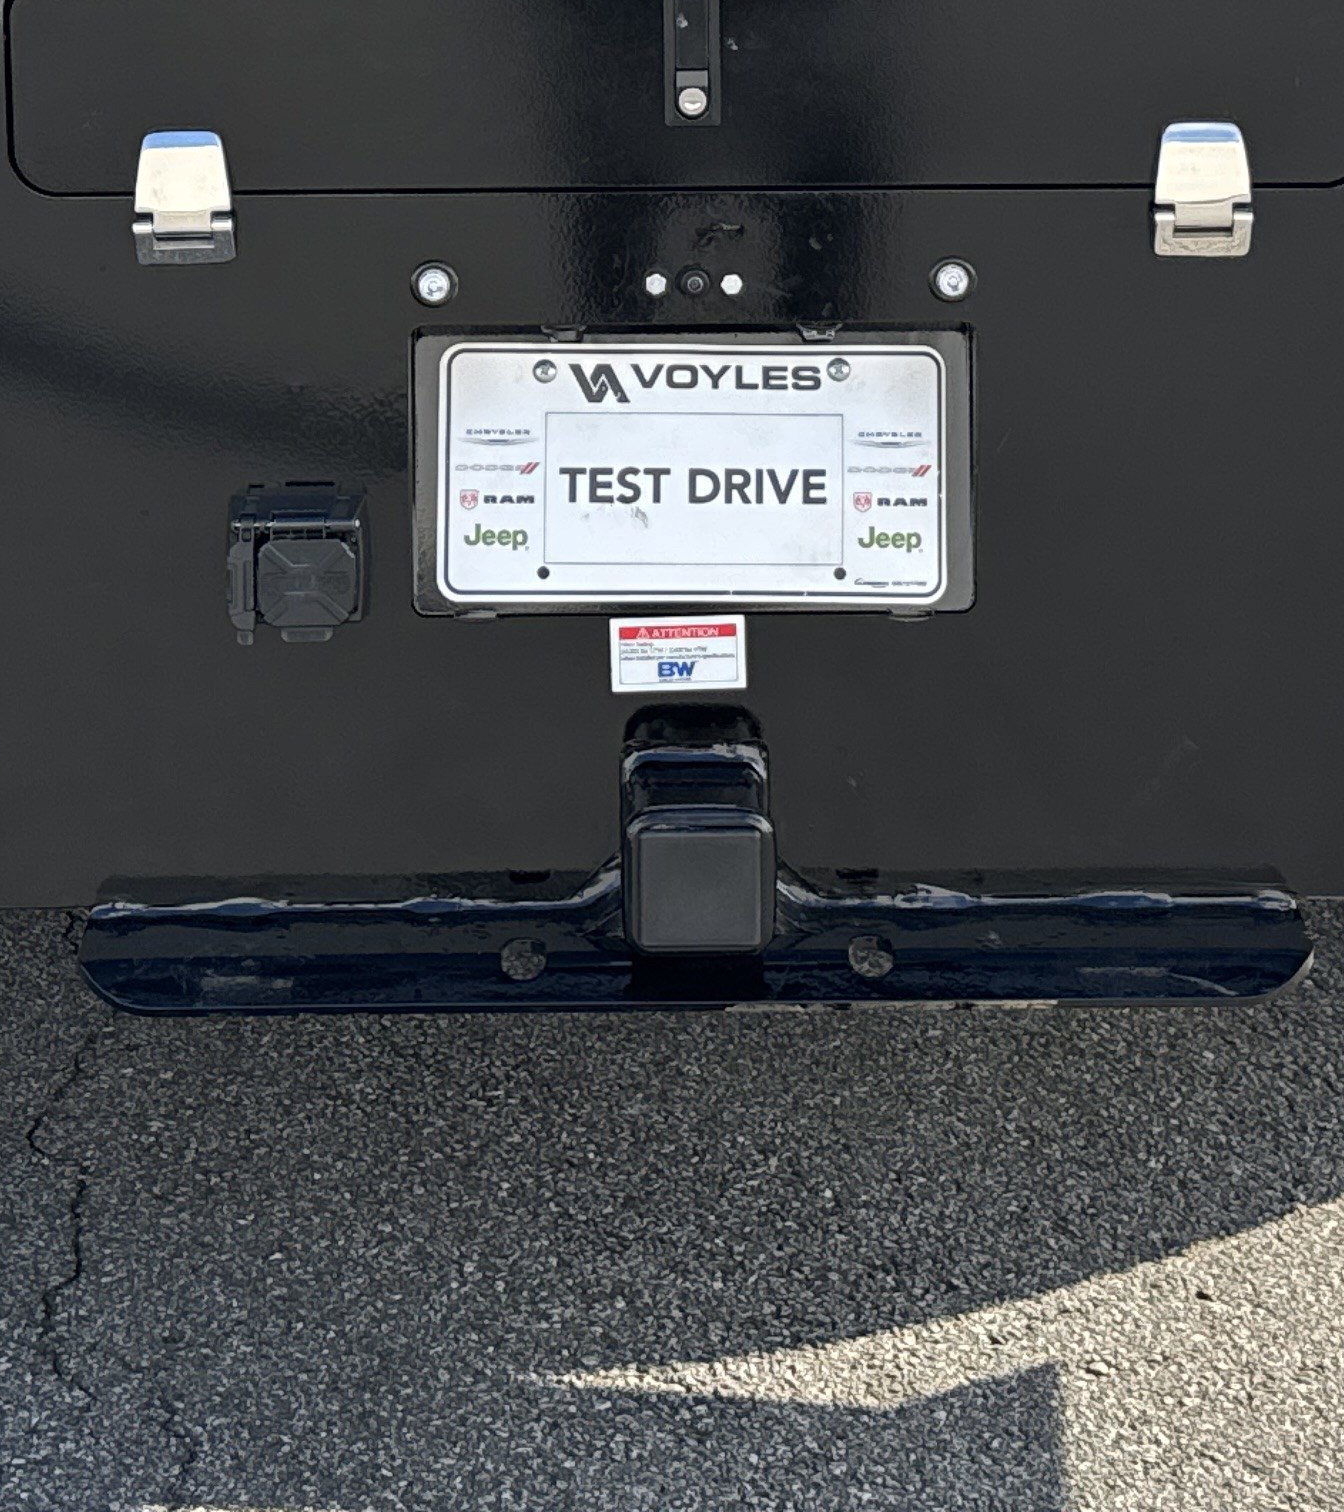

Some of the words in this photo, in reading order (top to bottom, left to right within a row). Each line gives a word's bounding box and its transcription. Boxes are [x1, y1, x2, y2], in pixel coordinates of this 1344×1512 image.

[630, 363, 822, 391] VOYLES
[483, 494, 535, 504] RAM
[559, 467, 671, 504] TEST
[688, 467, 827, 505] DRIVE
[877, 497, 928, 507] RAM
[463, 523, 529, 551] Jeep
[857, 526, 922, 553] Jeep
[651, 627, 719, 638] ATTENTION
